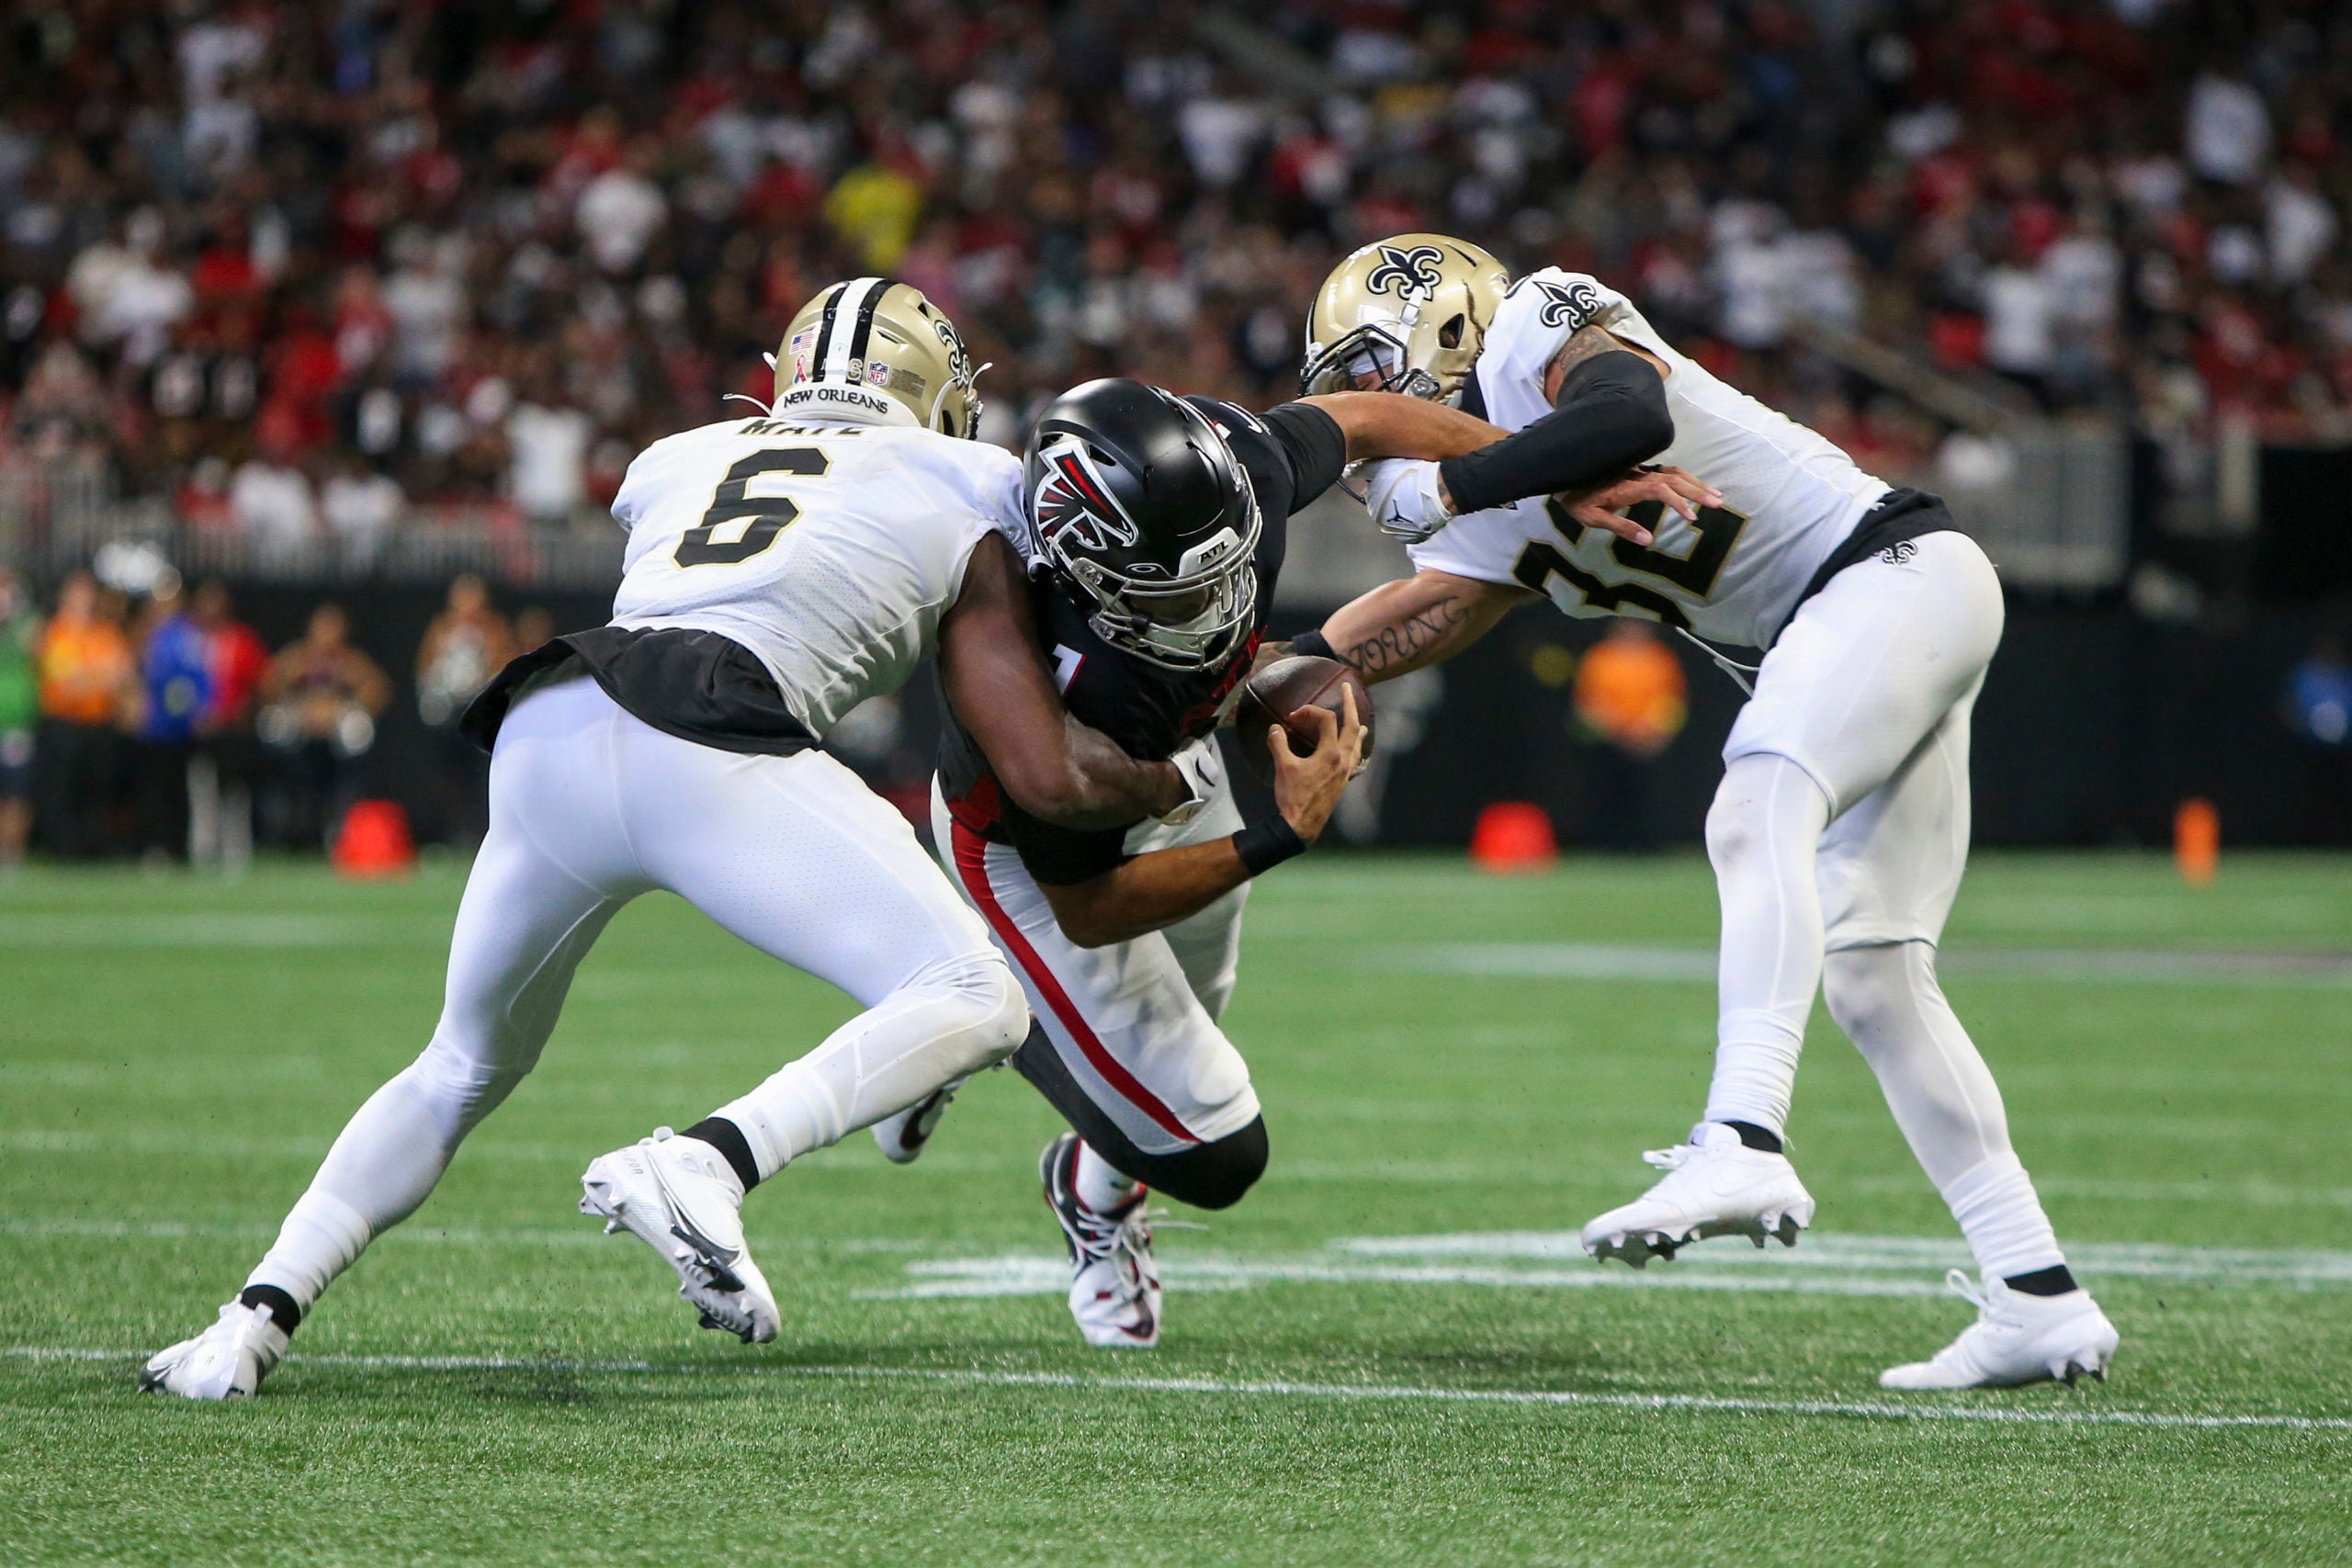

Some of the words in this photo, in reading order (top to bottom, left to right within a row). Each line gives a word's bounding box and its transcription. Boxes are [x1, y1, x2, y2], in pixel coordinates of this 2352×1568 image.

[869, 371, 886, 383] NFL
[784, 389, 813, 409] NEW
[818, 388, 888, 414] ORLEANS
[669, 445, 834, 570] 6
[1198, 540, 1229, 564] ATL
